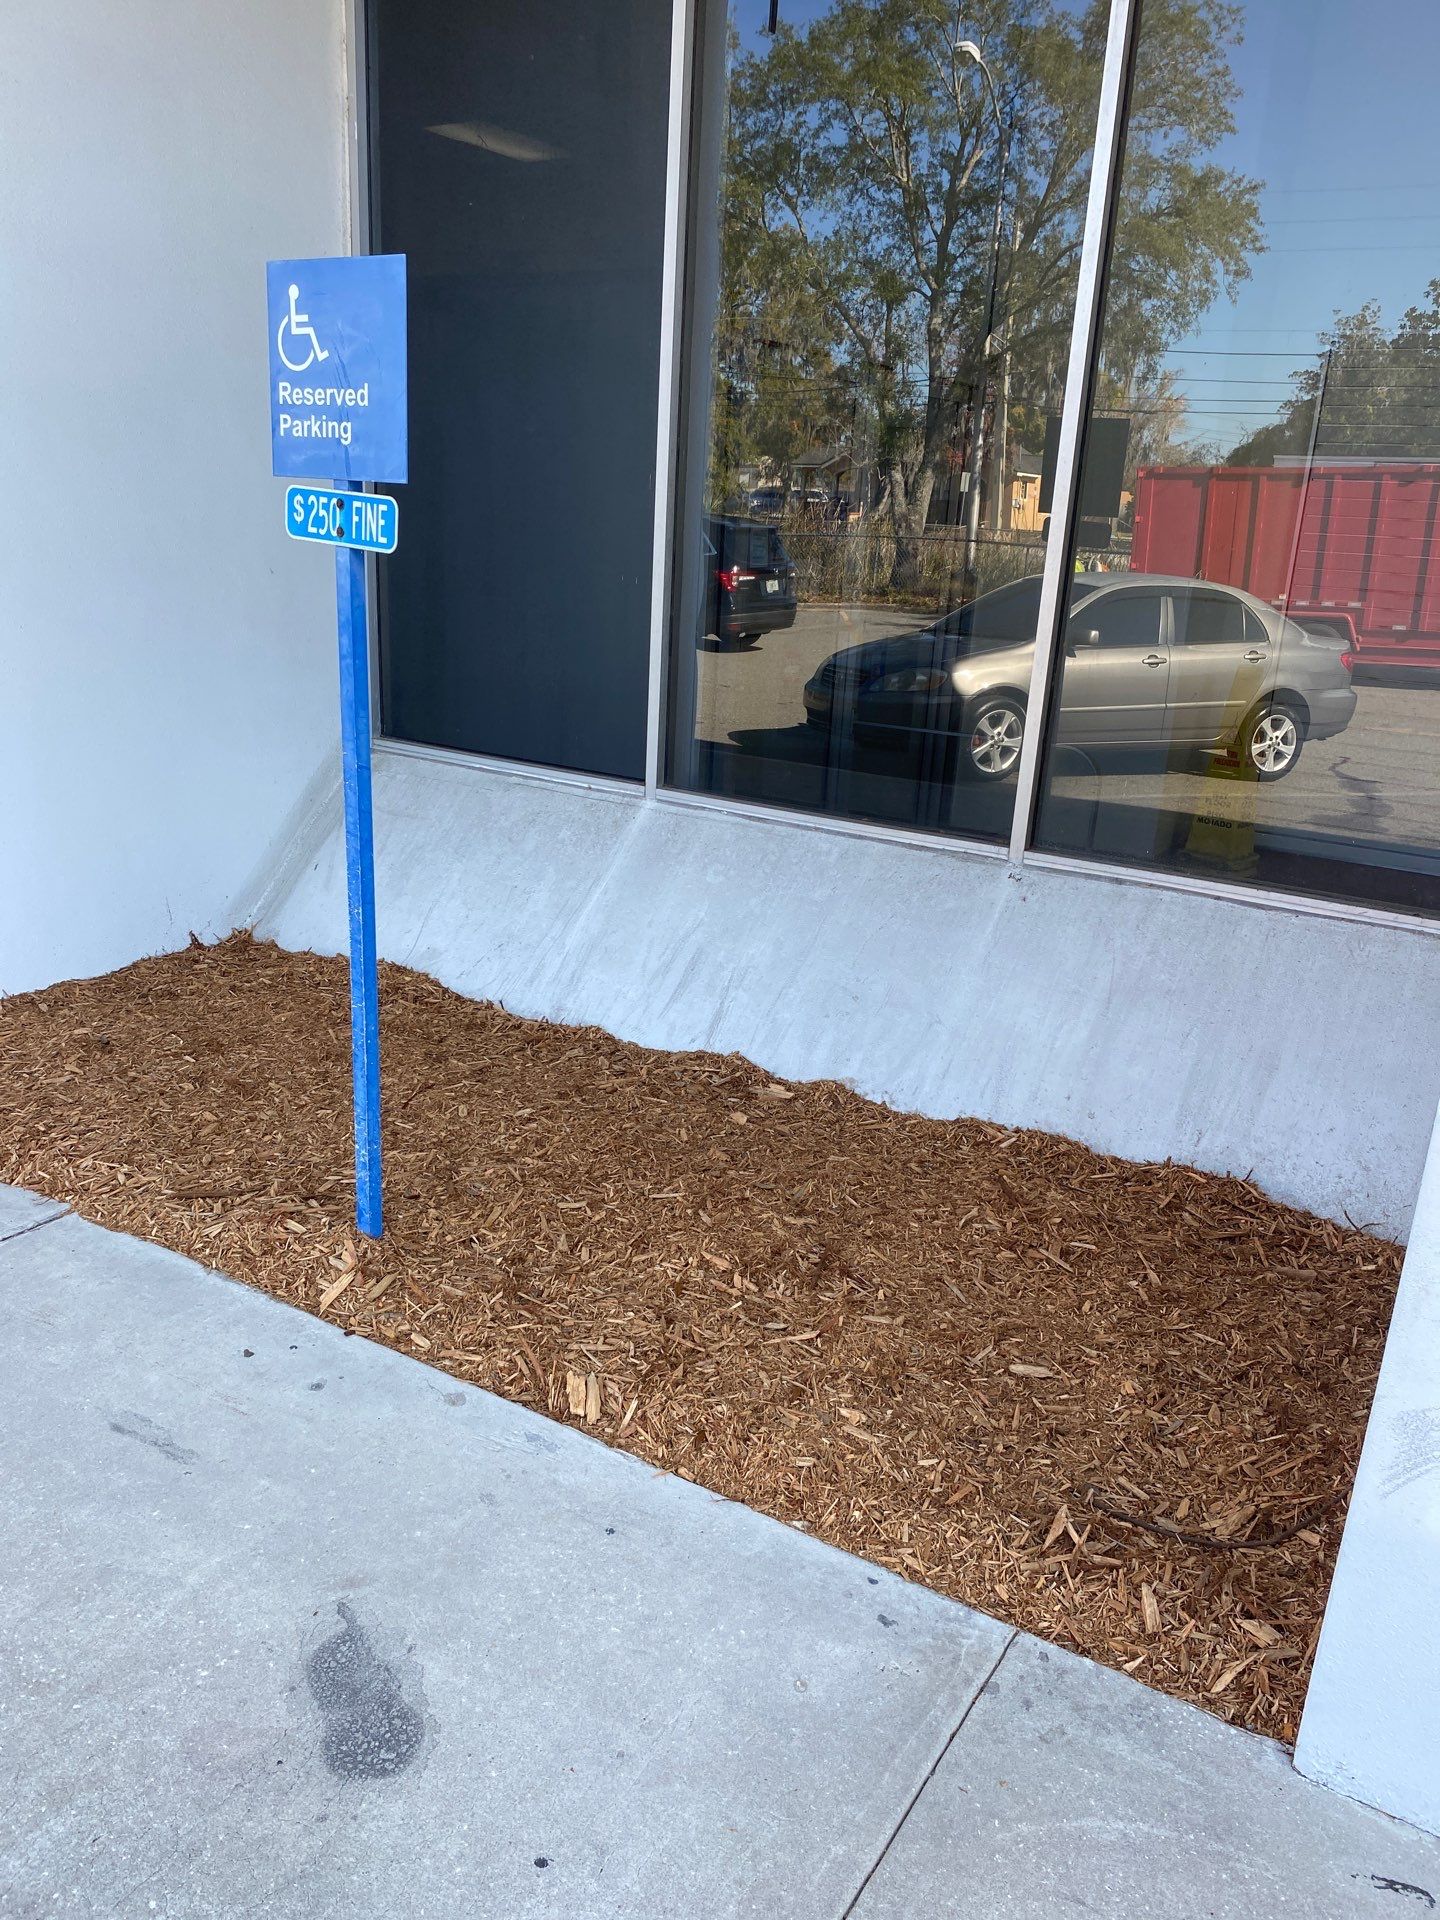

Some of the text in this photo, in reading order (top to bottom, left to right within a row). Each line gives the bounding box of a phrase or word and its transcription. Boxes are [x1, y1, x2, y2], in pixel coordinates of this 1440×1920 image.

[278, 381, 369, 407] Reserved
[279, 413, 352, 446] Parking
[352, 500, 388, 544] FINE
